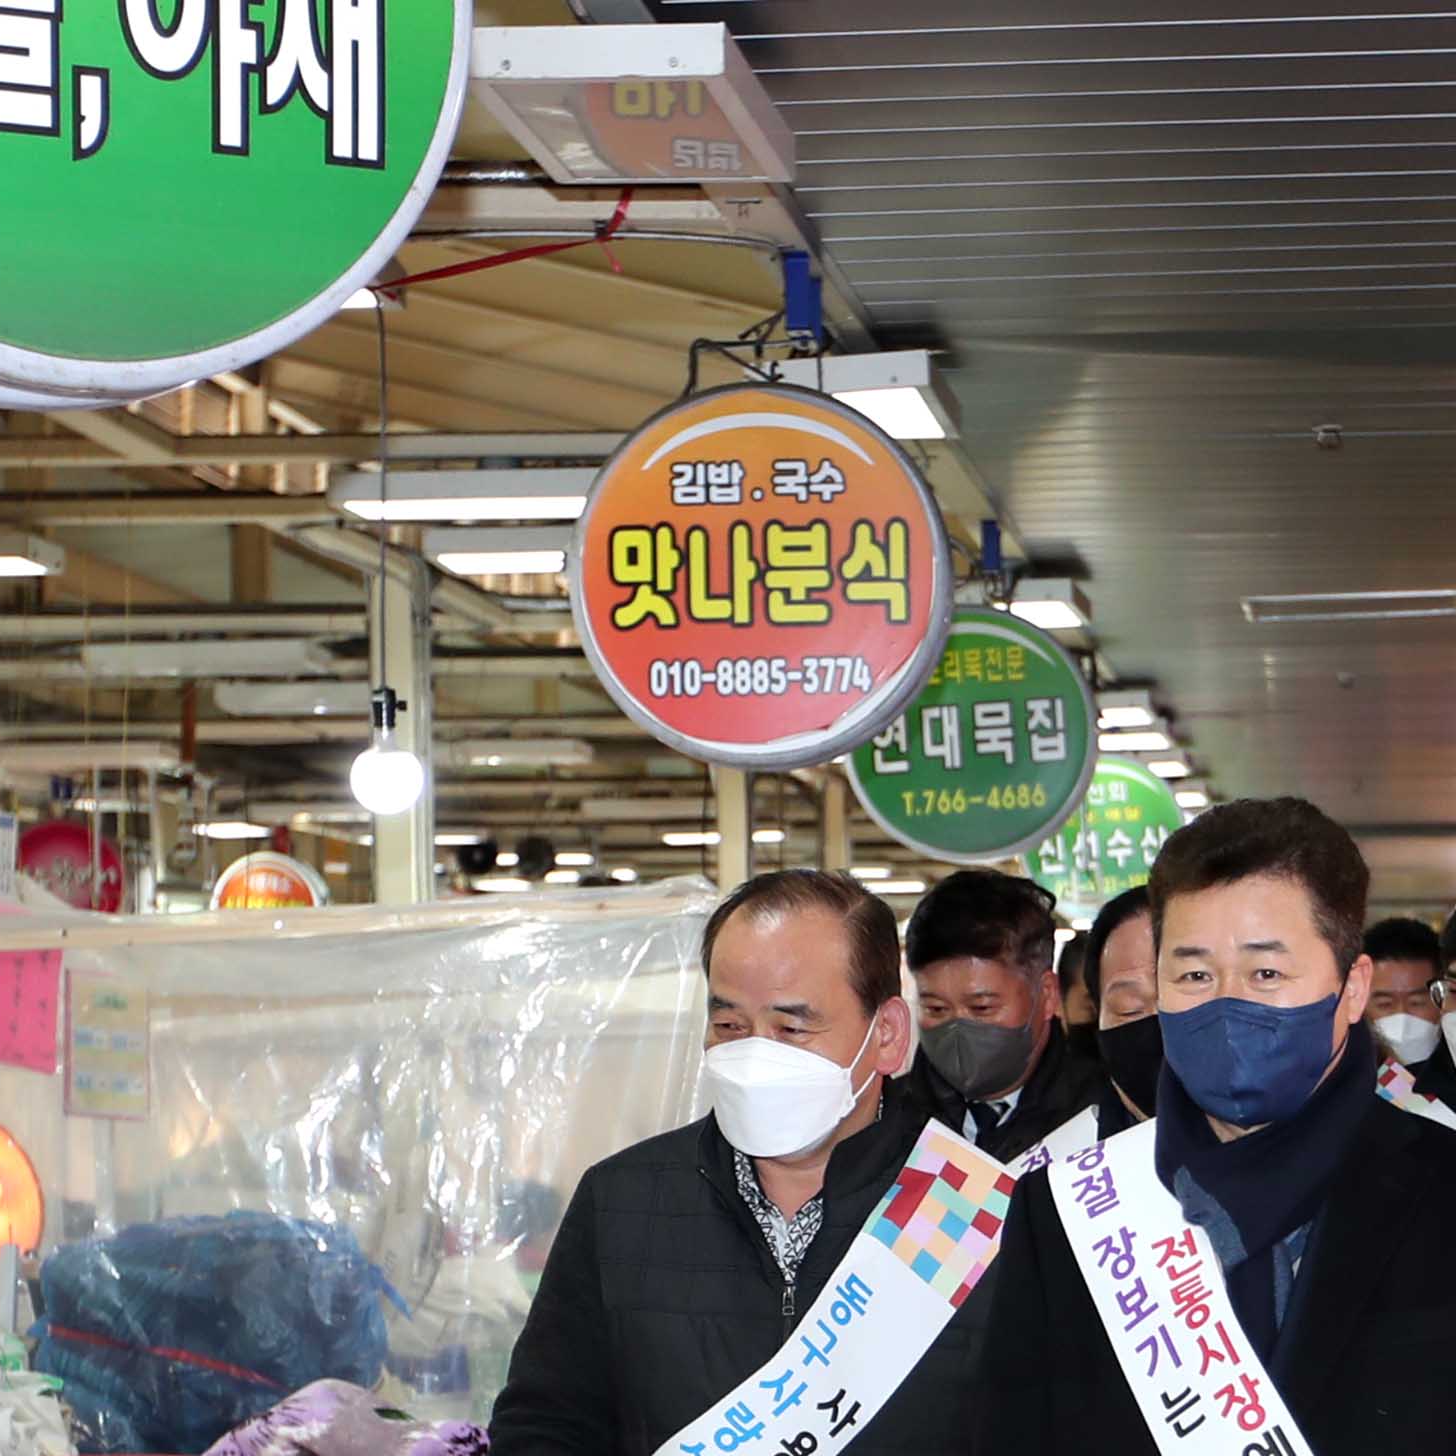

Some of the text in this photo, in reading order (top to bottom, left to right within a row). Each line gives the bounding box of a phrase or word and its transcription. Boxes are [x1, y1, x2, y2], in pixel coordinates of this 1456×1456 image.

[671, 461, 746, 505] 김밥
[772, 459, 846, 502] 국수
[611, 518, 910, 630] 맛나분식
[649, 656, 872, 697] 010-8885-3774
[901, 784, 1048, 817] T.766-4686
[1093, 1226, 1206, 1439] 장보기는
